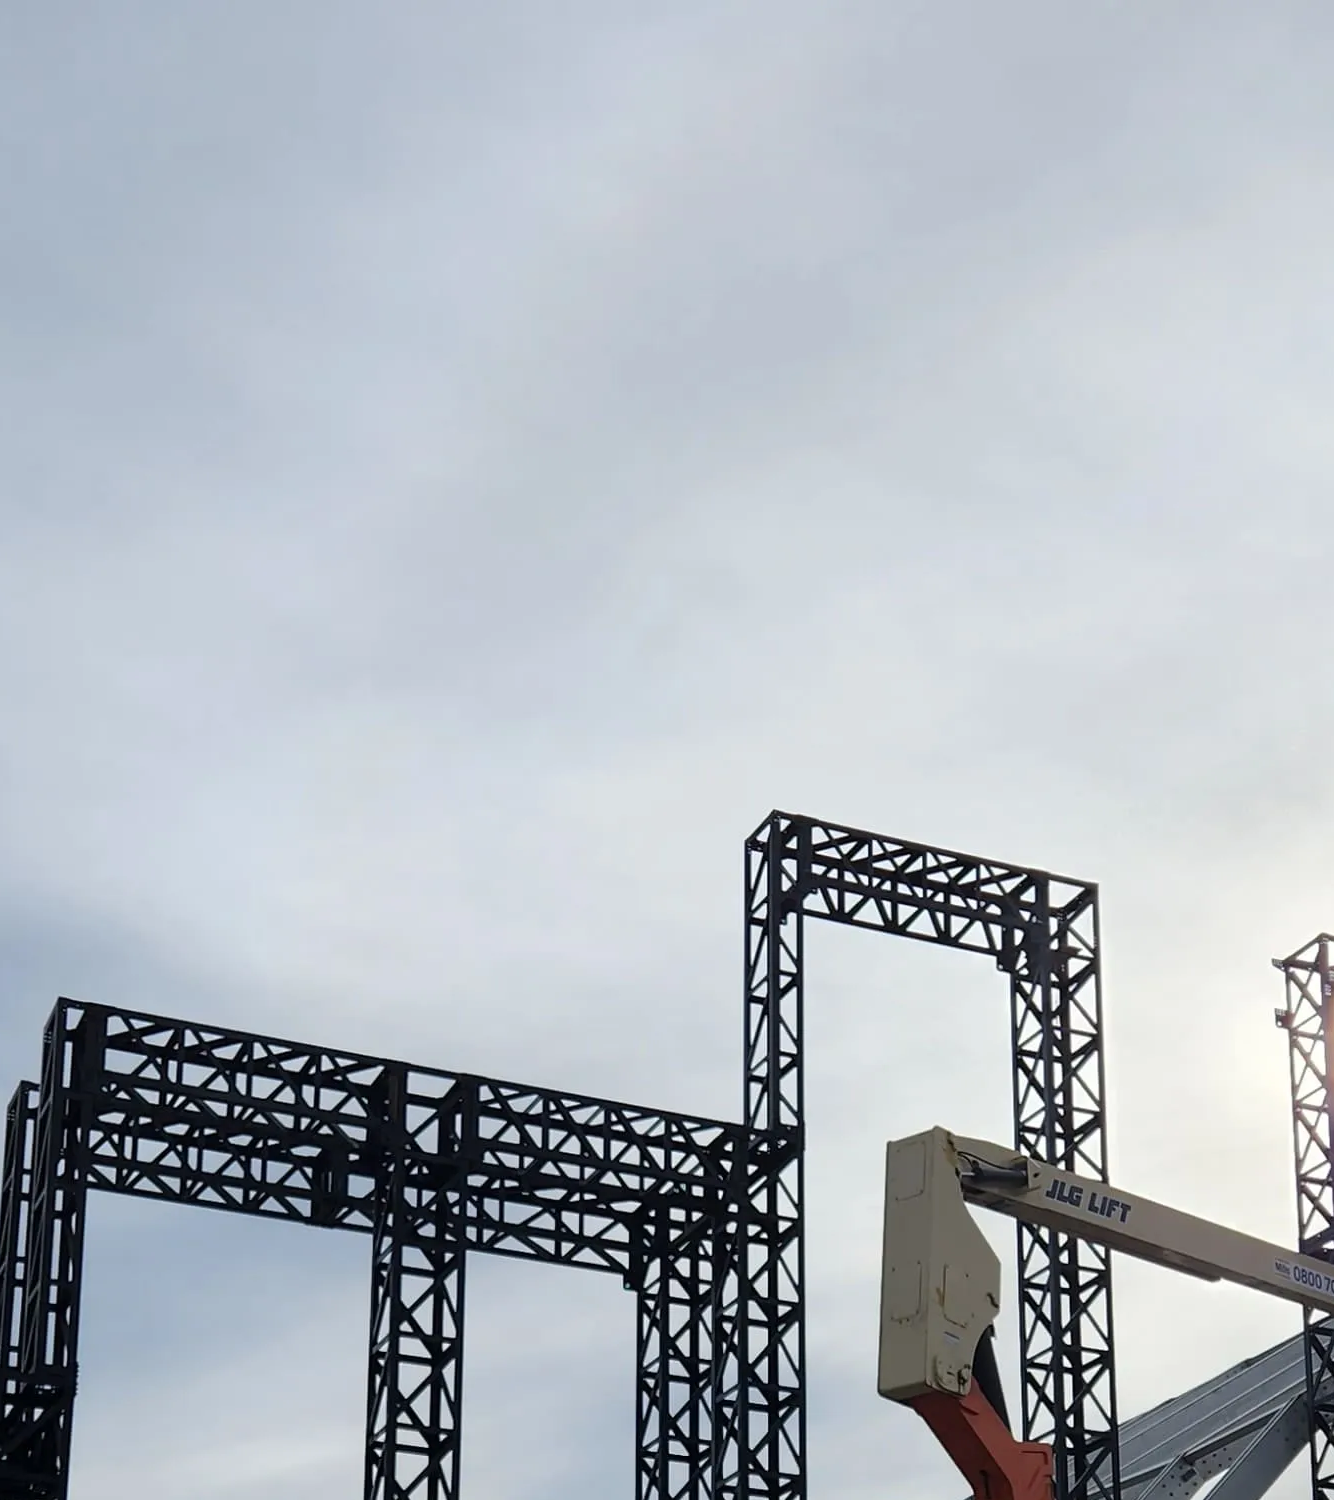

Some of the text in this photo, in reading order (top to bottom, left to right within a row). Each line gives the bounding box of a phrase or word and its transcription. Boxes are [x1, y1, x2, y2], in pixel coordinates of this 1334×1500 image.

[1045, 1178, 1132, 1223] JLG LIFT
[1293, 1265, 1322, 1290] 0800
